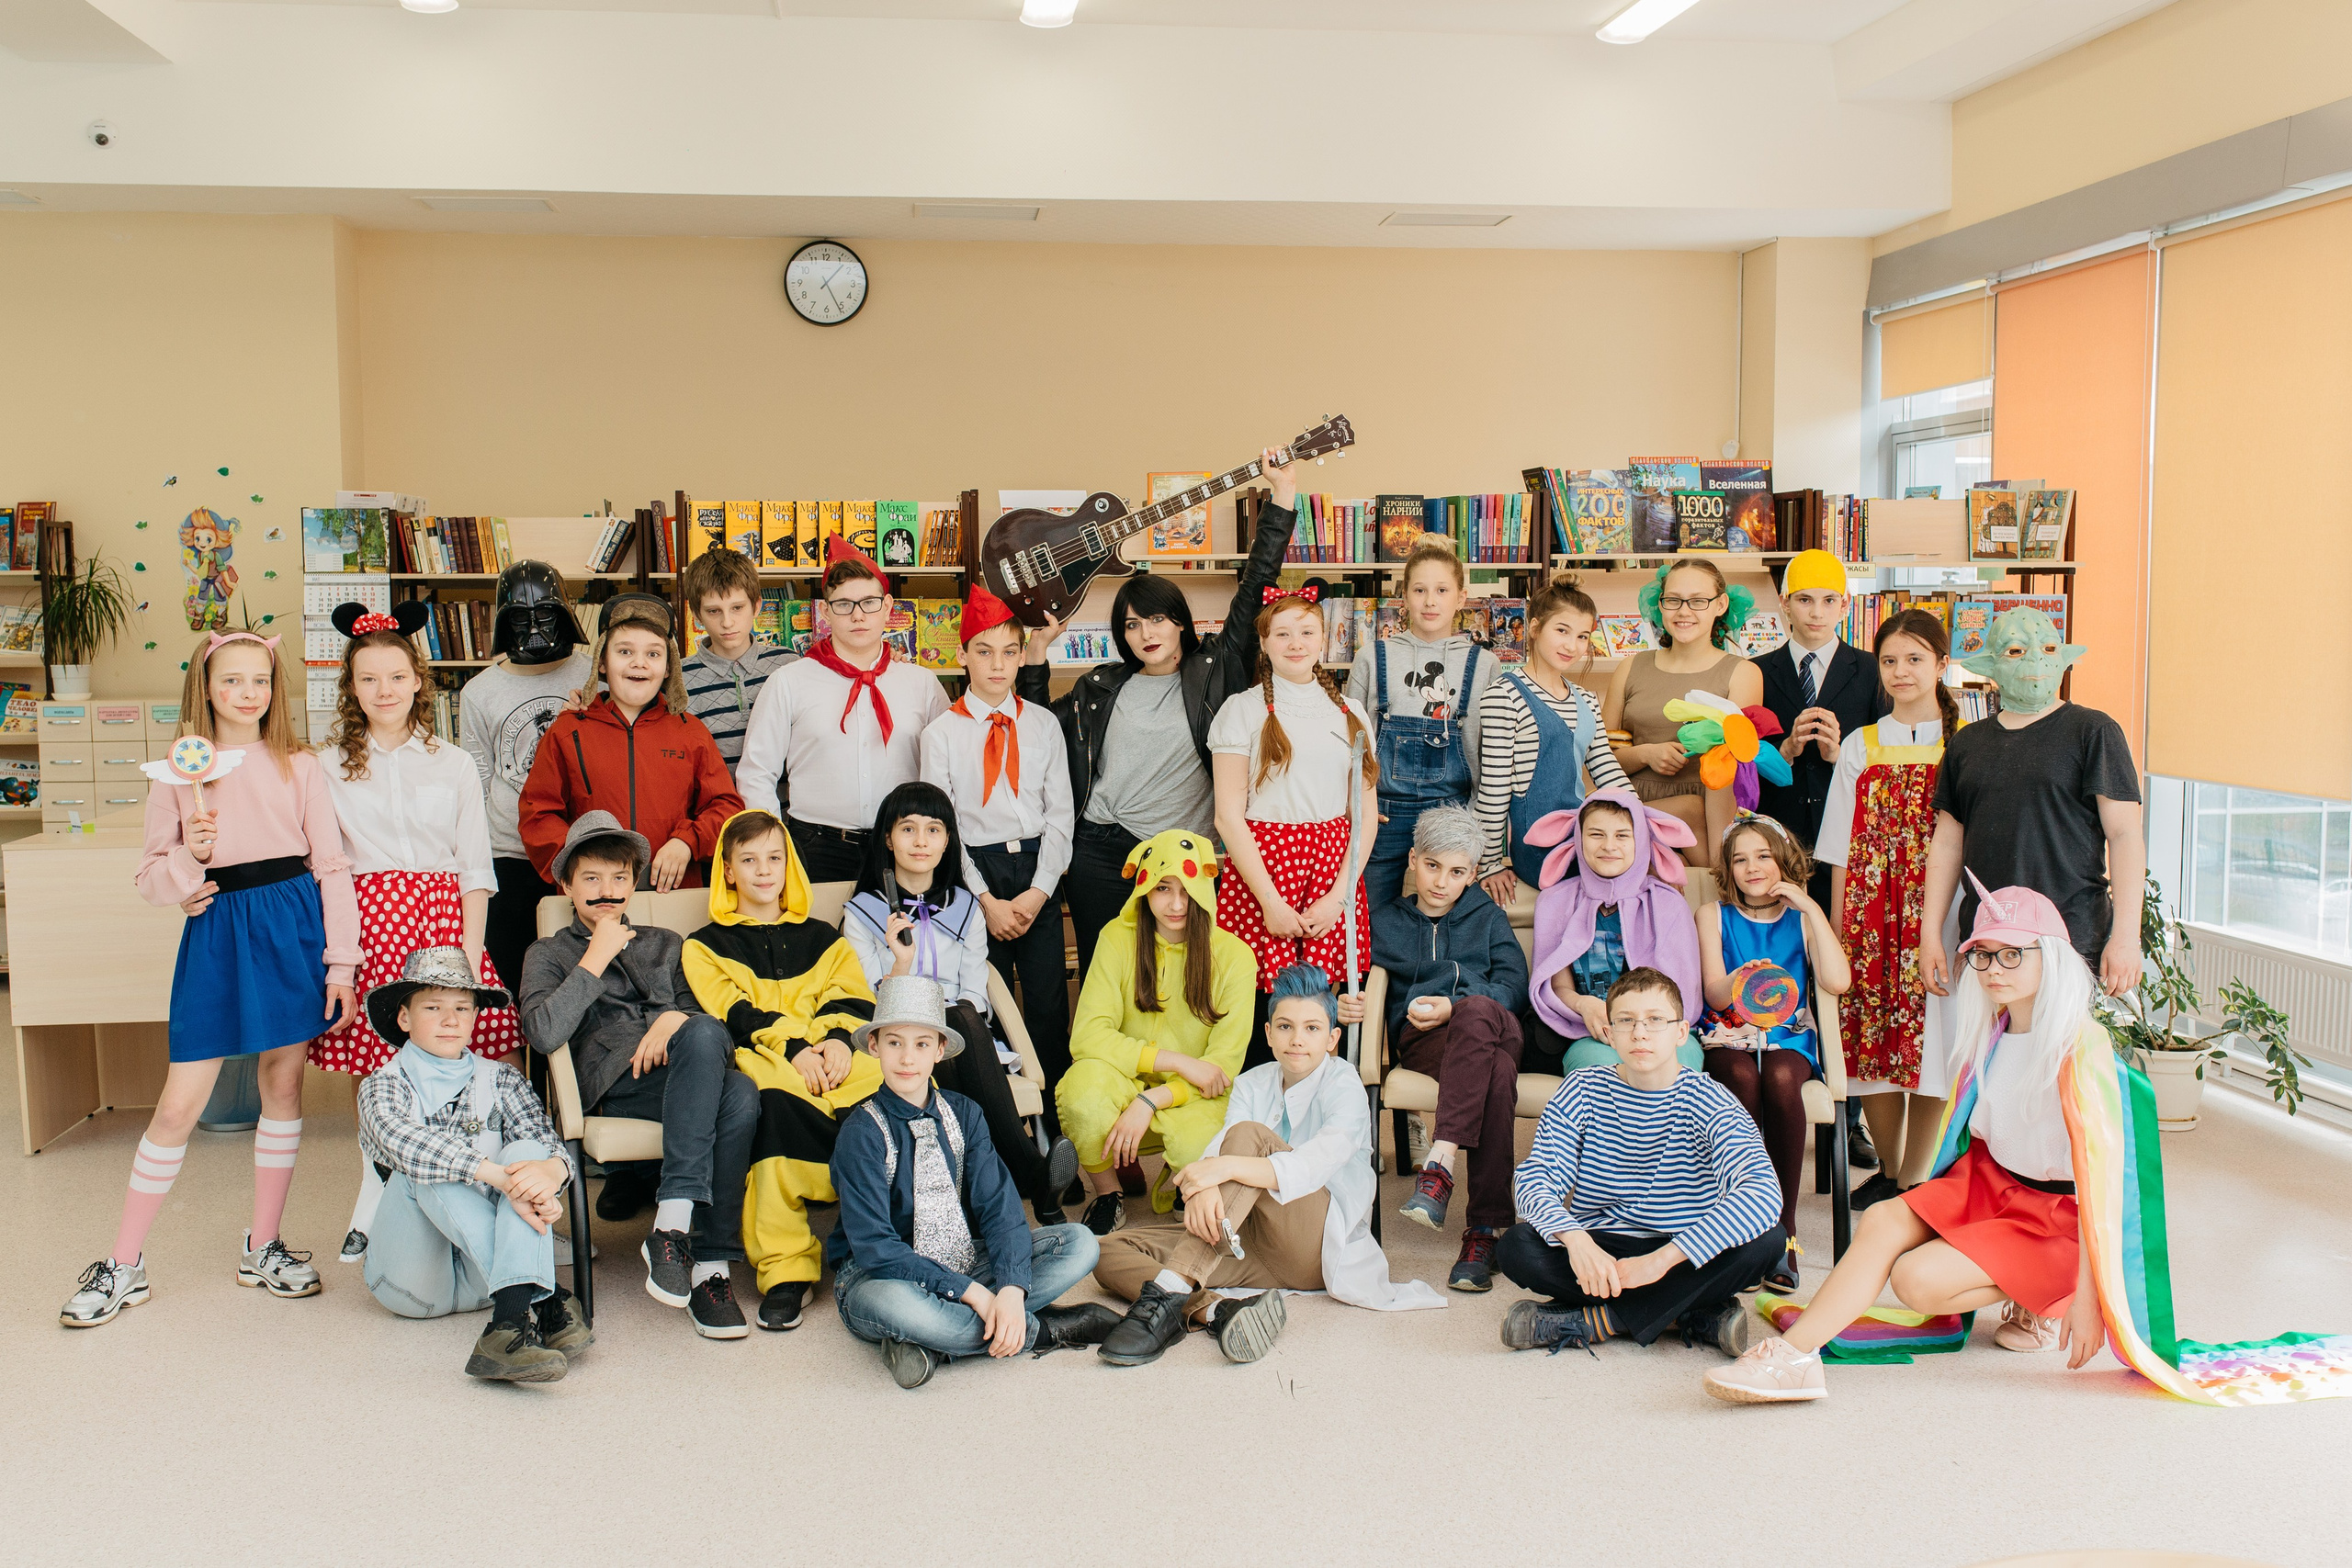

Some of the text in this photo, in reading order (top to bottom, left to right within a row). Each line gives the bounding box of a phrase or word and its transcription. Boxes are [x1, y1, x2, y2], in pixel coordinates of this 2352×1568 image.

[846, 266, 851, 275] 2
[851, 279, 855, 288] 3
[801, 290, 807, 299] 8
[823, 305, 830, 313] 6
[840, 301, 844, 310] 5
[1642, 474, 1686, 491] Наука
[1709, 479, 1767, 490] Вселенная
[729, 503, 756, 513] Макс
[766, 502, 794, 513] Макс
[880, 503, 908, 513] Макс
[1383, 507, 1423, 515] НАРНИИ
[1577, 494, 1626, 518] 200
[1680, 496, 1724, 517] 1000
[738, 512, 759, 524] Фра
[1577, 517, 1625, 526] ФАКТОВ
[1974, 600, 2064, 612] ВЕРШЕННО
[503, 715, 526, 755] TAKE
[522, 701, 556, 718] THE
